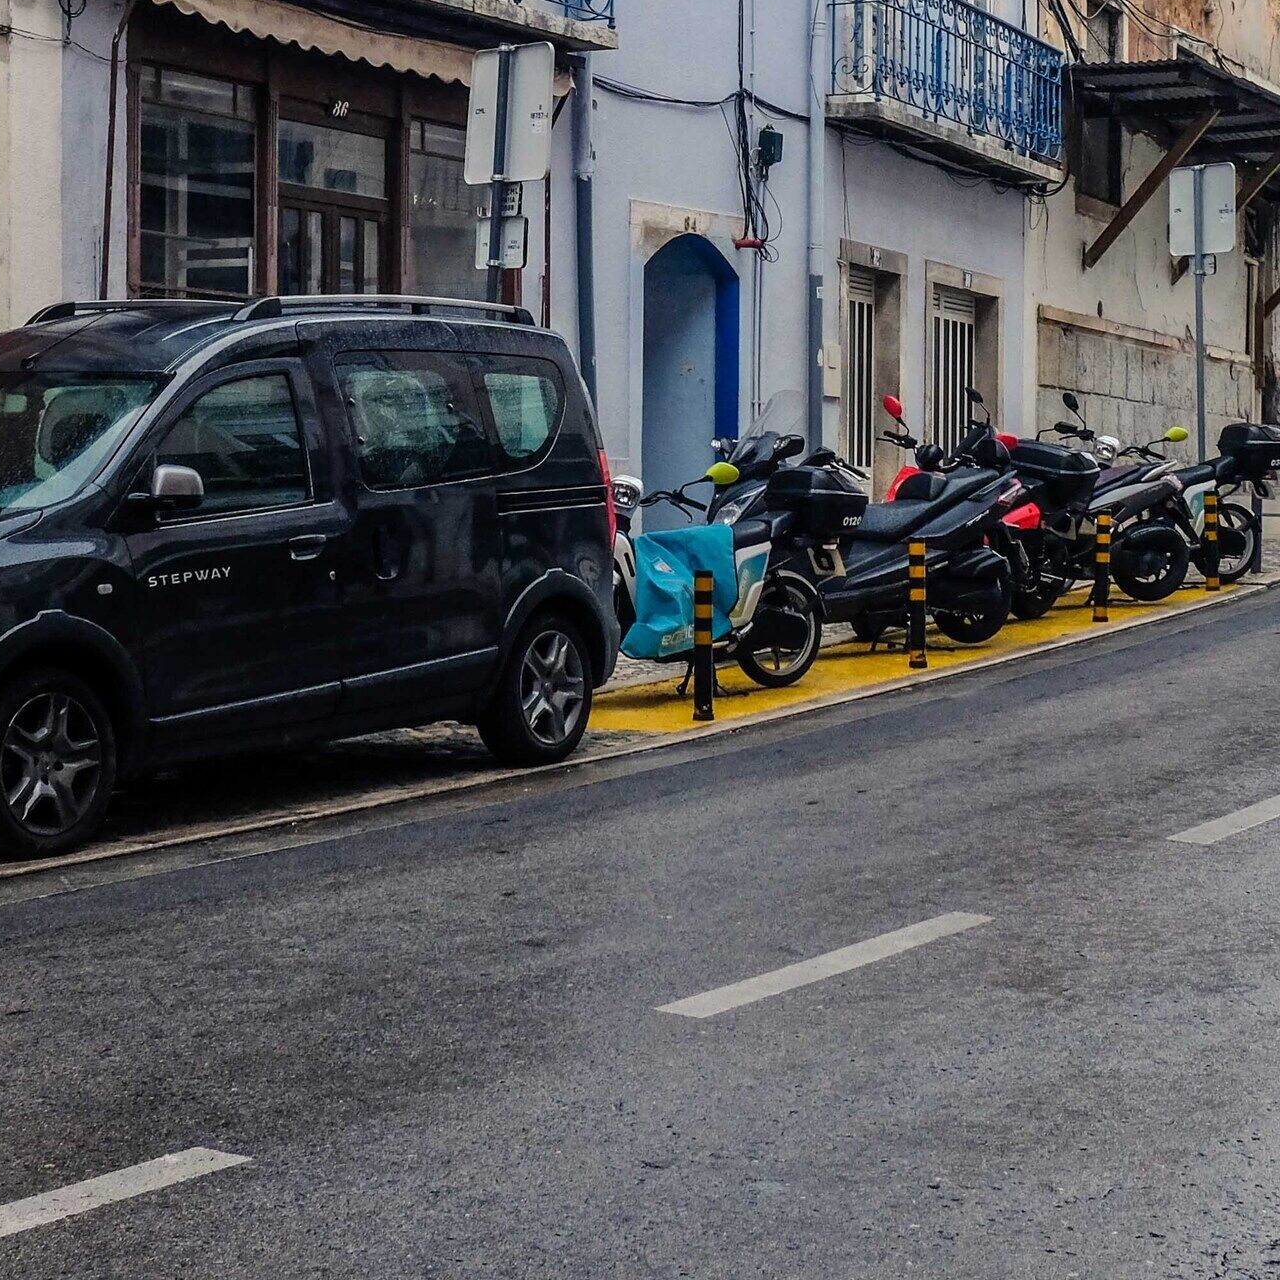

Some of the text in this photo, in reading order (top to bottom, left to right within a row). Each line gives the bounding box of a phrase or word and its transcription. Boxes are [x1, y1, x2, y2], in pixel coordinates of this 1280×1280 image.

[332, 100, 350, 118] 86
[842, 516, 862, 527] 0120
[148, 566, 231, 588] STEPWAY
